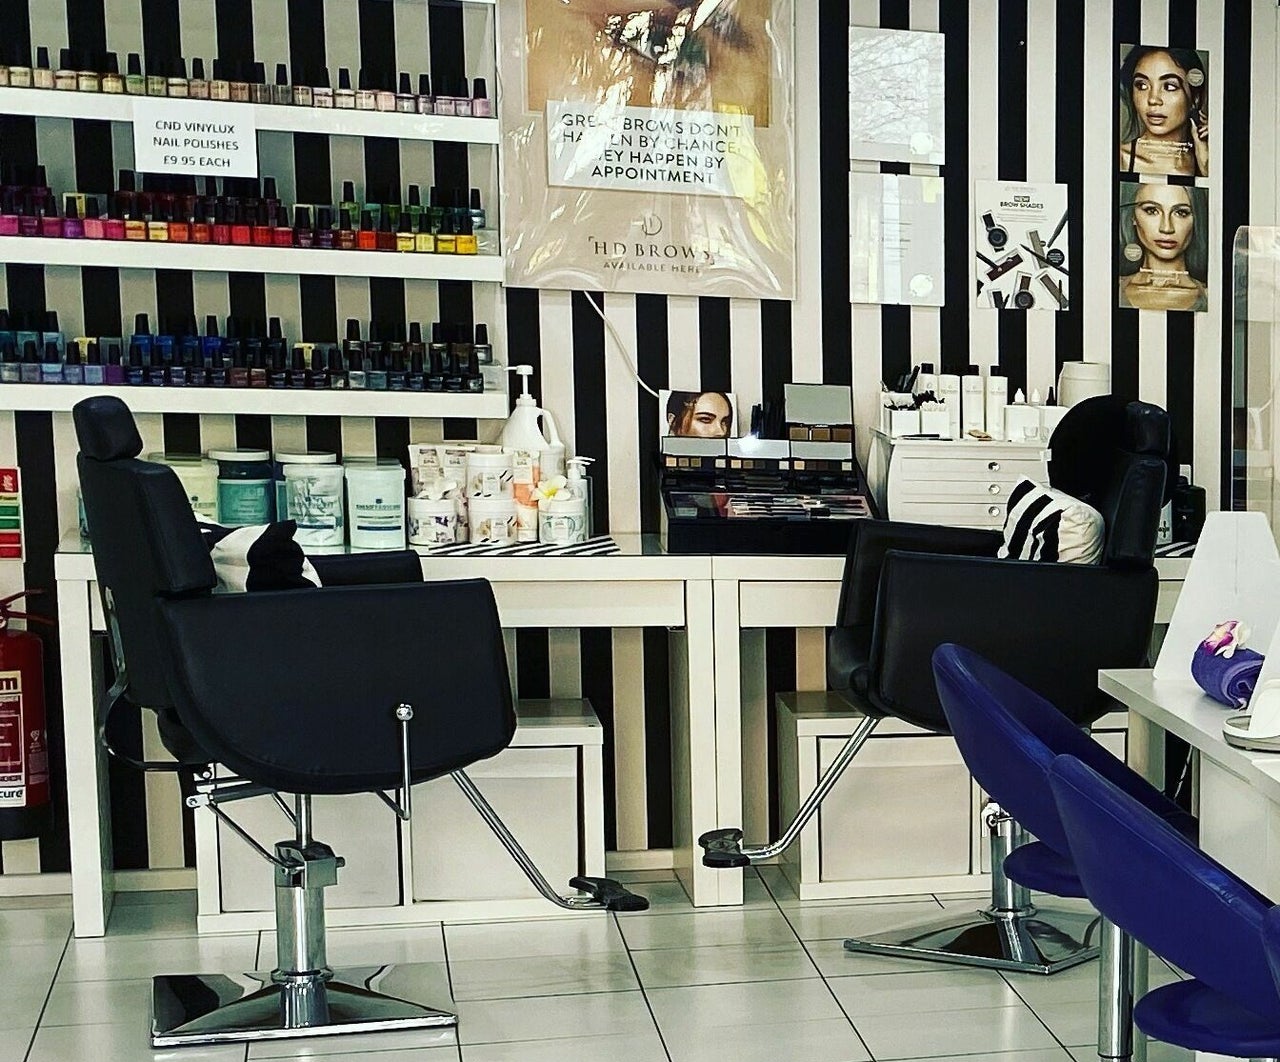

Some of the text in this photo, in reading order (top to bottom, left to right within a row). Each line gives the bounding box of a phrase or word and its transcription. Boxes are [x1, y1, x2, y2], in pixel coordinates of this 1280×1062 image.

[155, 120, 235, 134] CND VINYLUX
[623, 118, 684, 134] BROWS
[690, 122, 742, 137] DON'T
[153, 137, 239, 151] NAIL POLISHES
[639, 135, 660, 149] BY
[199, 157, 231, 168] EACH
[630, 151, 698, 167] HAPPEN
[704, 156, 725, 170] BY
[591, 165, 715, 184] APPOINTMENT
